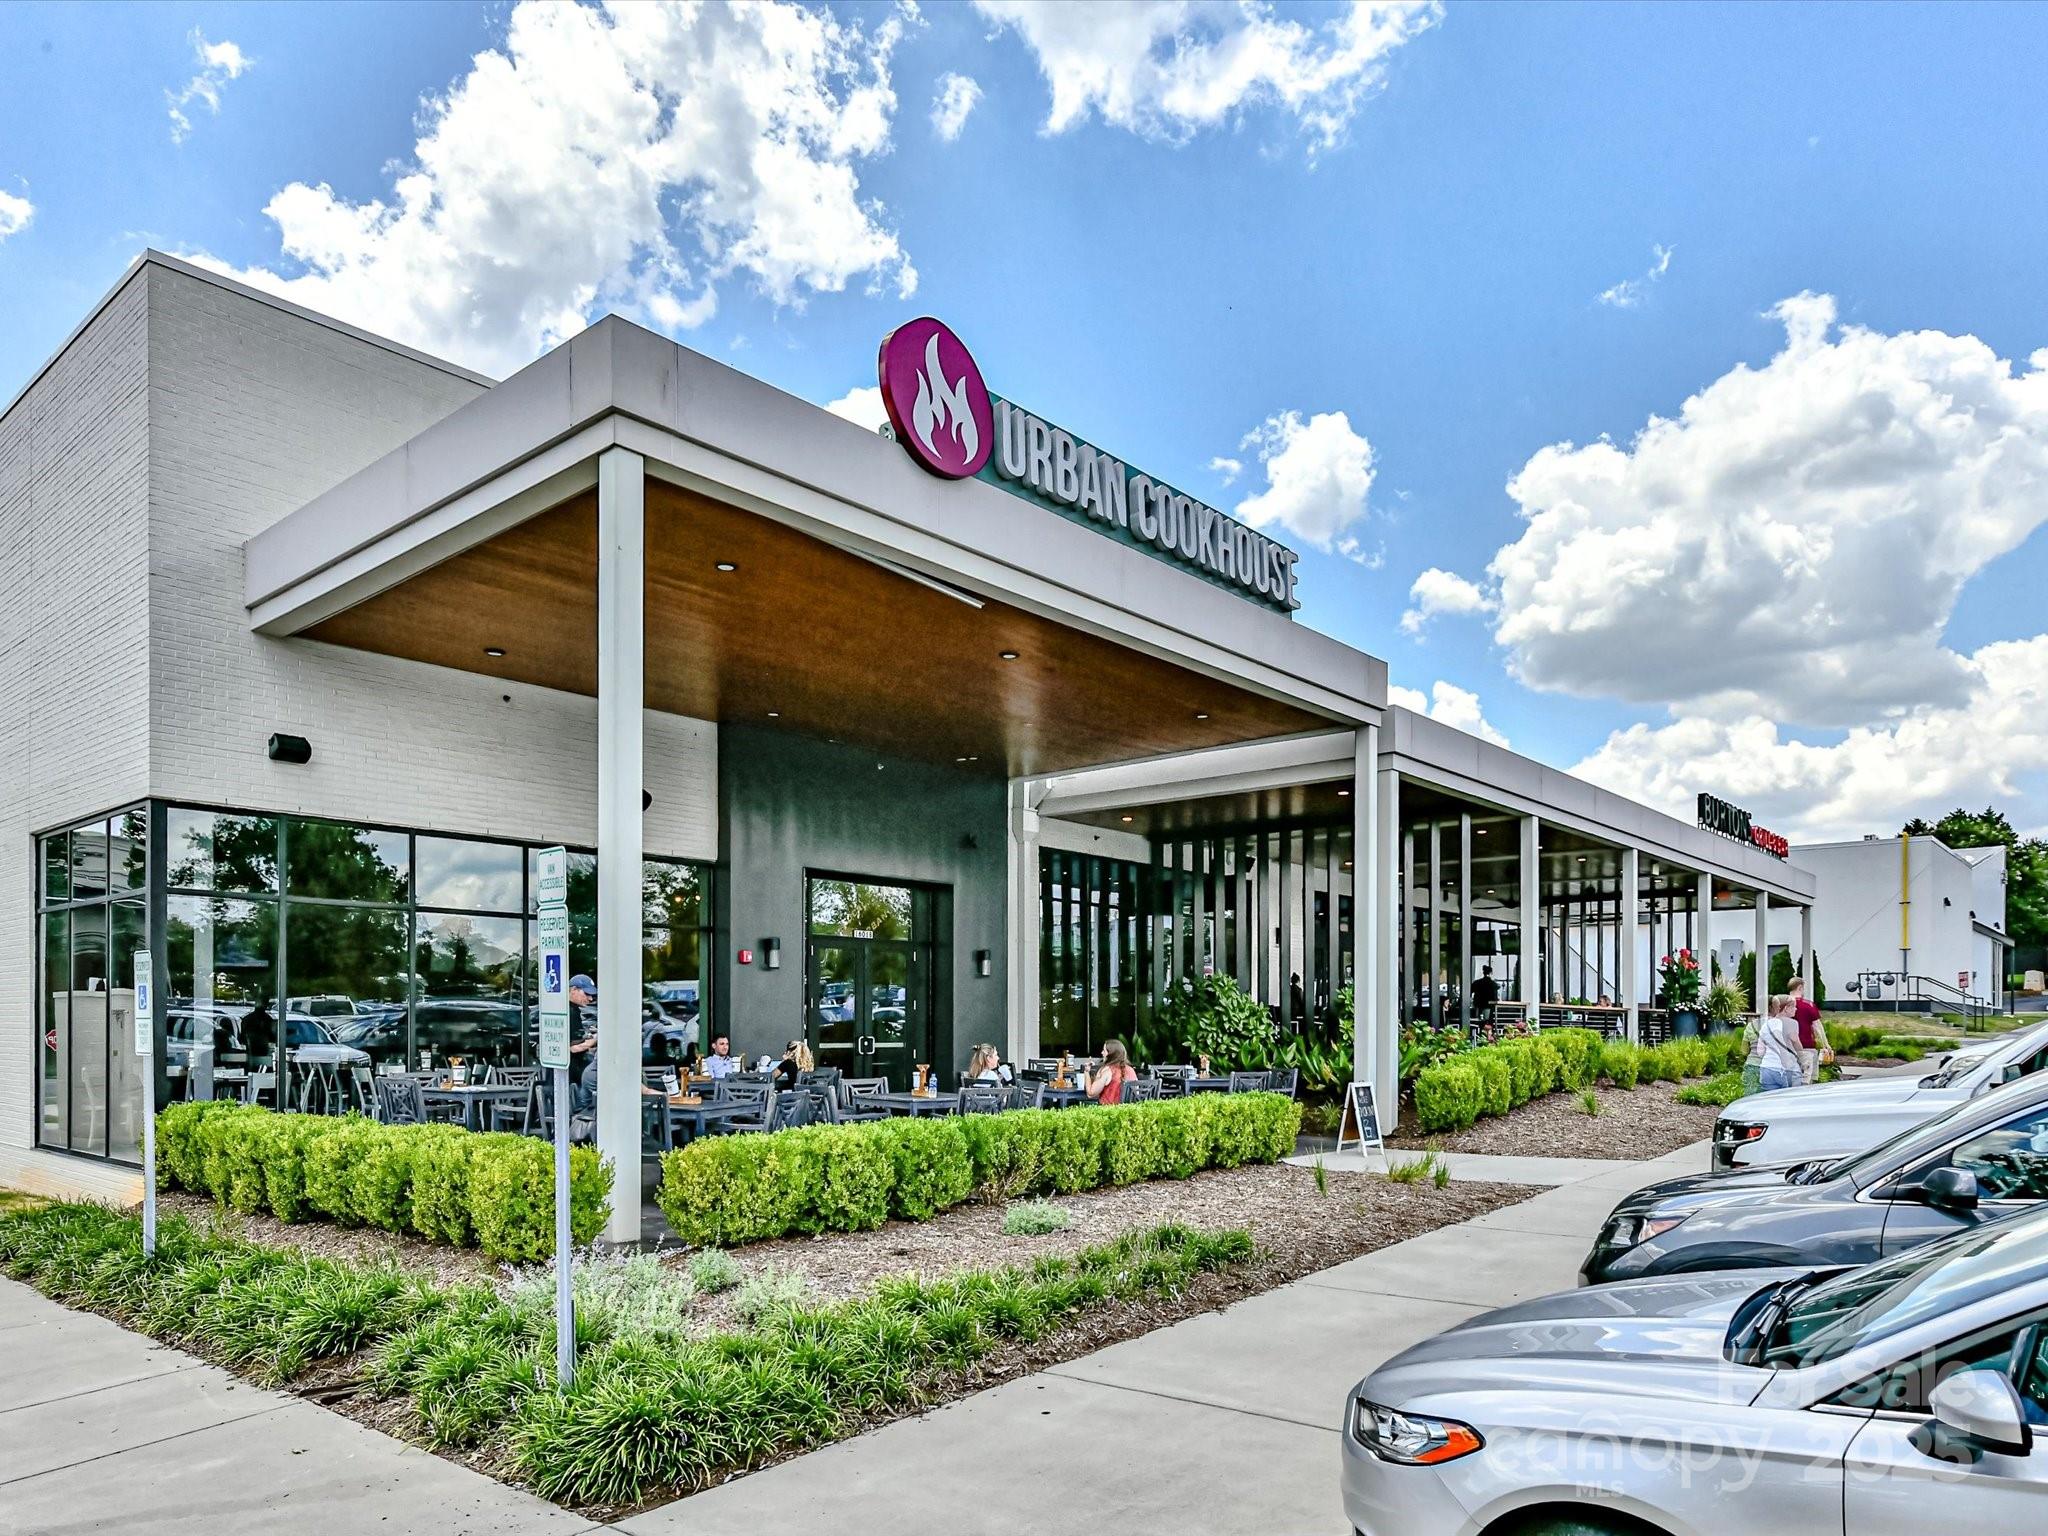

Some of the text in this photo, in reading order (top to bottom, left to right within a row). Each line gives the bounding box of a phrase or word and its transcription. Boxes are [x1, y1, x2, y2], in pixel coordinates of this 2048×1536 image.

[993, 399, 1301, 611] URBAN COOKHOUSE
[540, 917, 565, 931] RESERVED
[541, 935, 565, 949] PARKING
